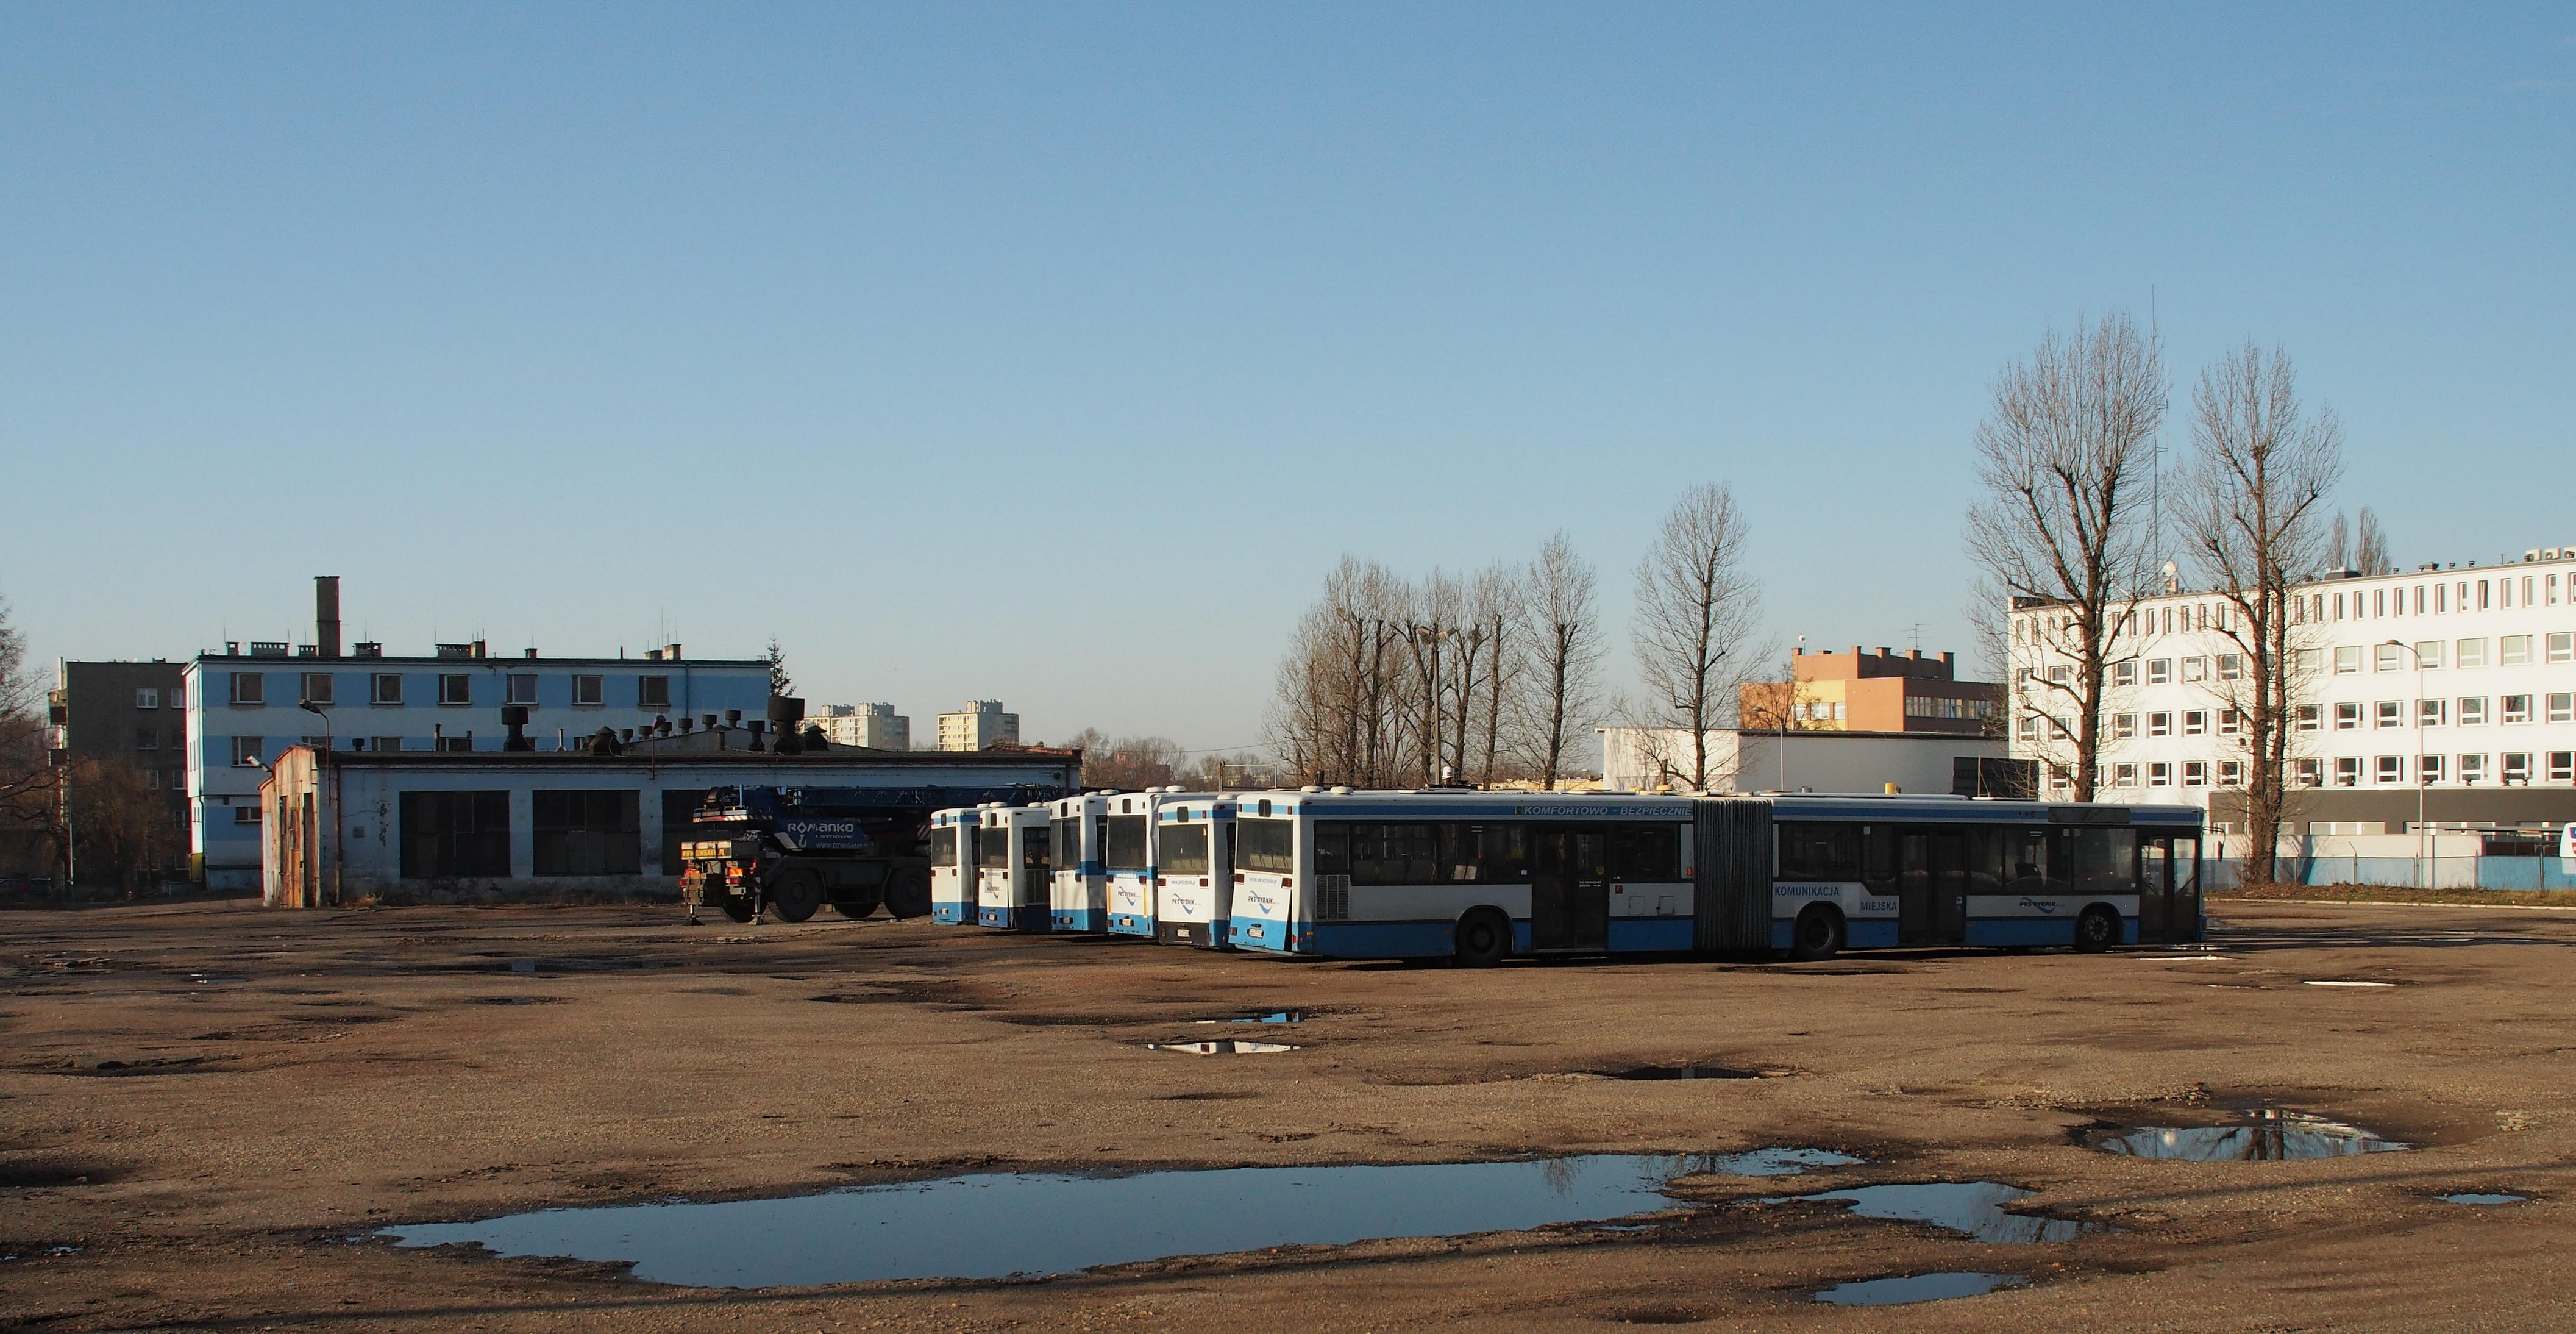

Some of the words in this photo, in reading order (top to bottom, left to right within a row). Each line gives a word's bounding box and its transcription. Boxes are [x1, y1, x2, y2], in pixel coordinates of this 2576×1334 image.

[1524, 807, 1608, 815] KOMFORTOWO
[1620, 807, 1693, 815] BEZPIECZNIE
[1774, 886, 1840, 896] KOMUNIKACJA
[1860, 901, 1897, 911] MIEJSKA
